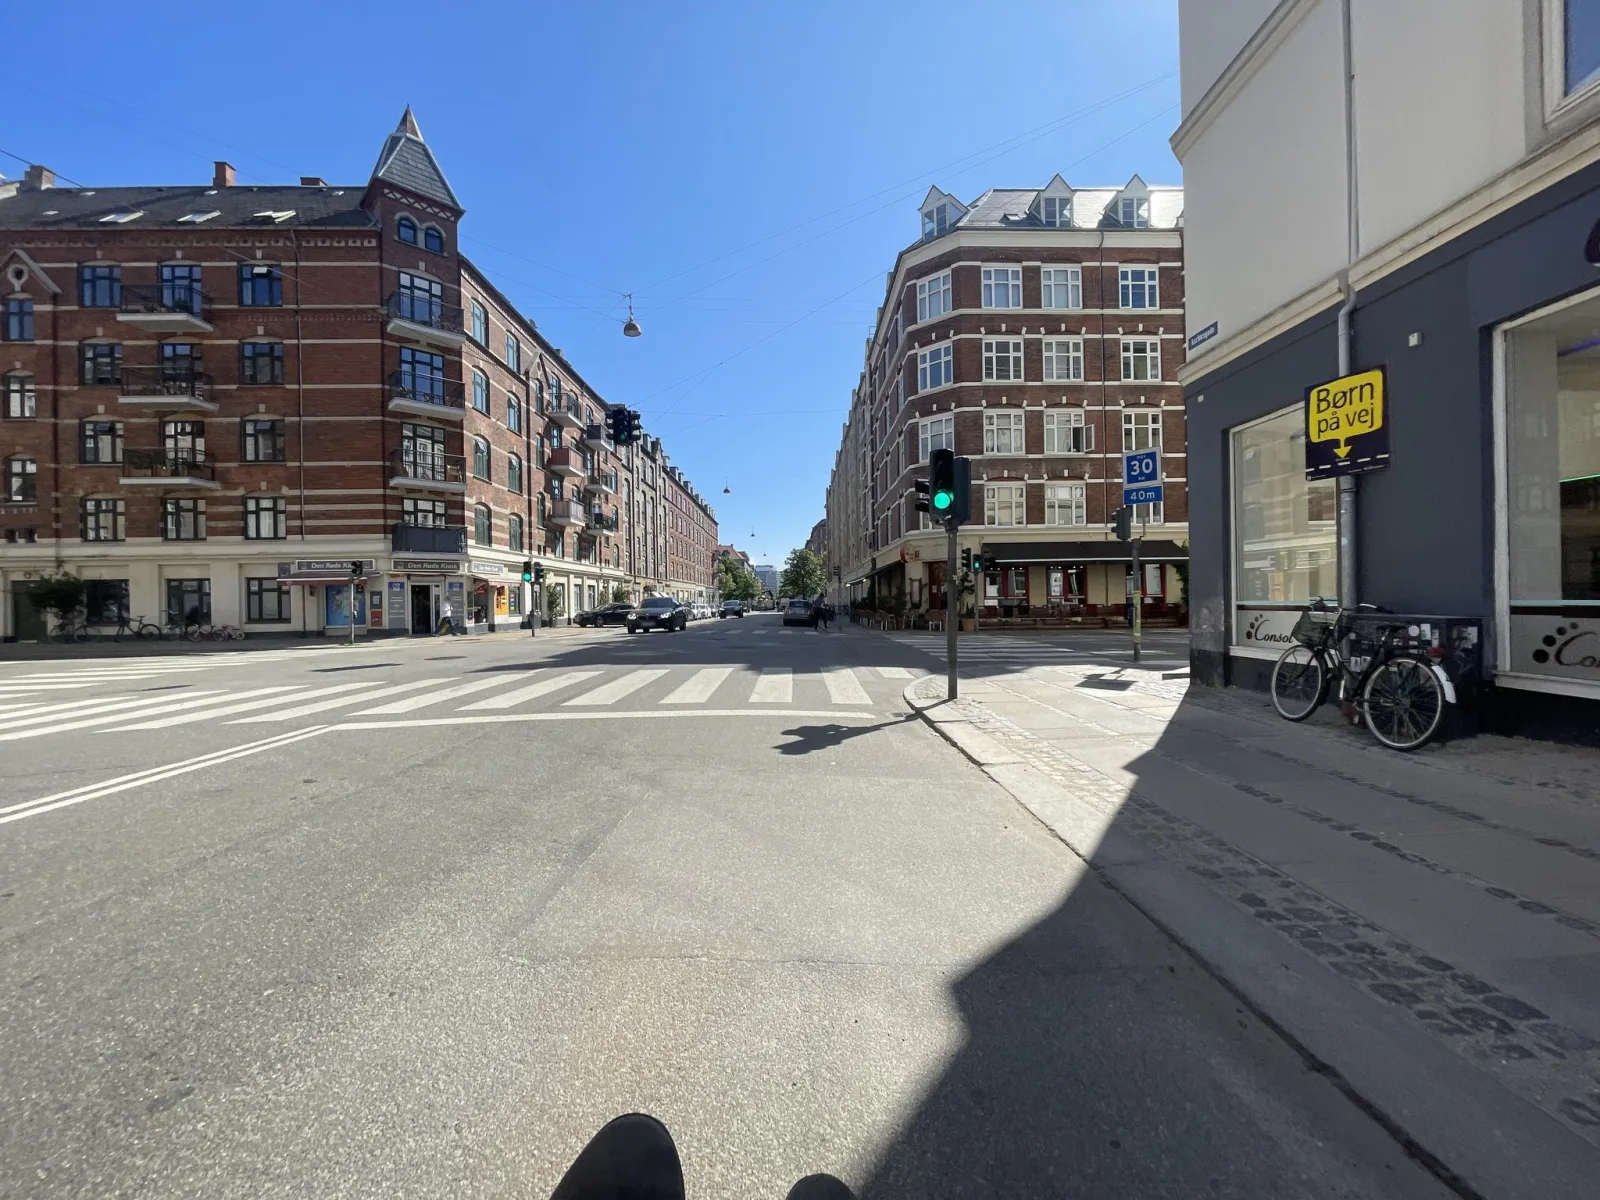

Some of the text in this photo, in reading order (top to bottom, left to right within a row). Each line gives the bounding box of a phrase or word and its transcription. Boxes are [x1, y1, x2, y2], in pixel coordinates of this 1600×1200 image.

[1316, 382, 1375, 415] Børn
[1317, 402, 1375, 439] på vej
[1130, 458, 1154, 476] 30
[440, 562, 458, 570] Kiosk
